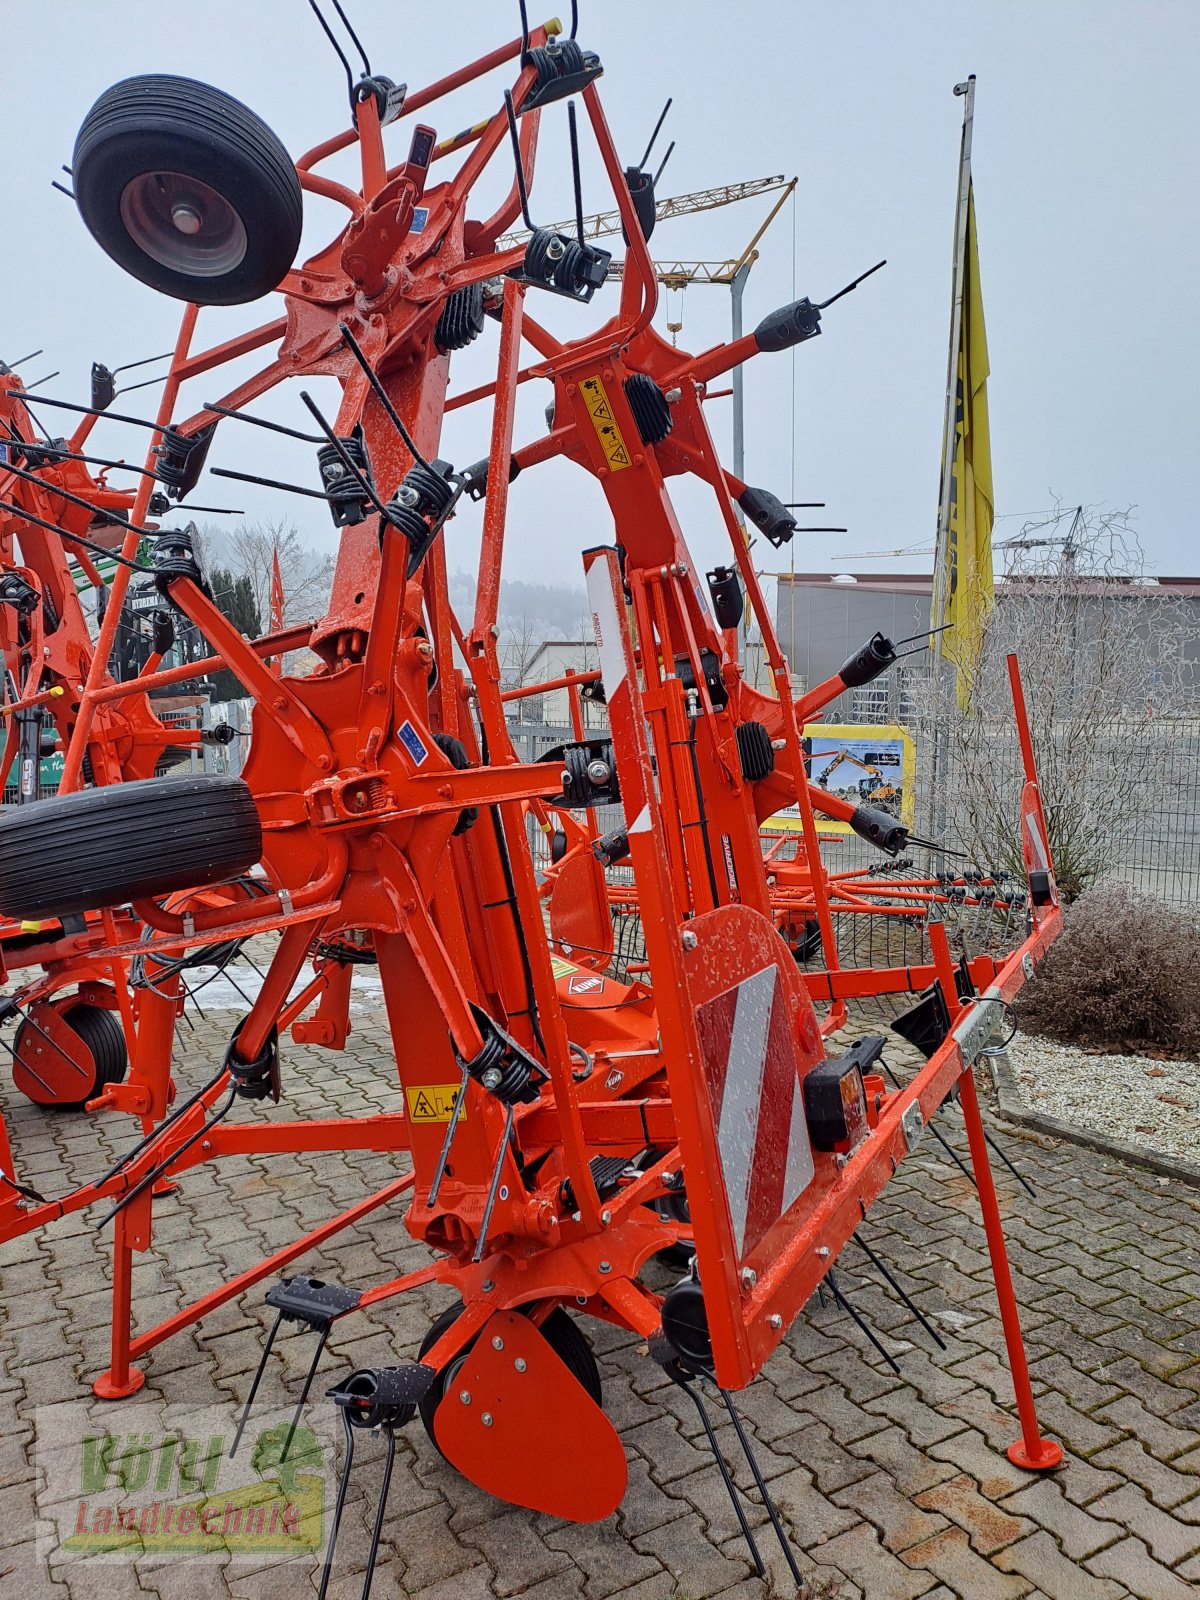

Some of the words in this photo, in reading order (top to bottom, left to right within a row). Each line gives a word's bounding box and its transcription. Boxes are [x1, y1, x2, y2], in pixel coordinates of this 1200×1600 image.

[132, 595, 159, 609] HYDREMA
[721, 835, 738, 889] DIGIDRIVE
[572, 978, 602, 993] KUHN
[607, 1072, 622, 1087] KUHN
